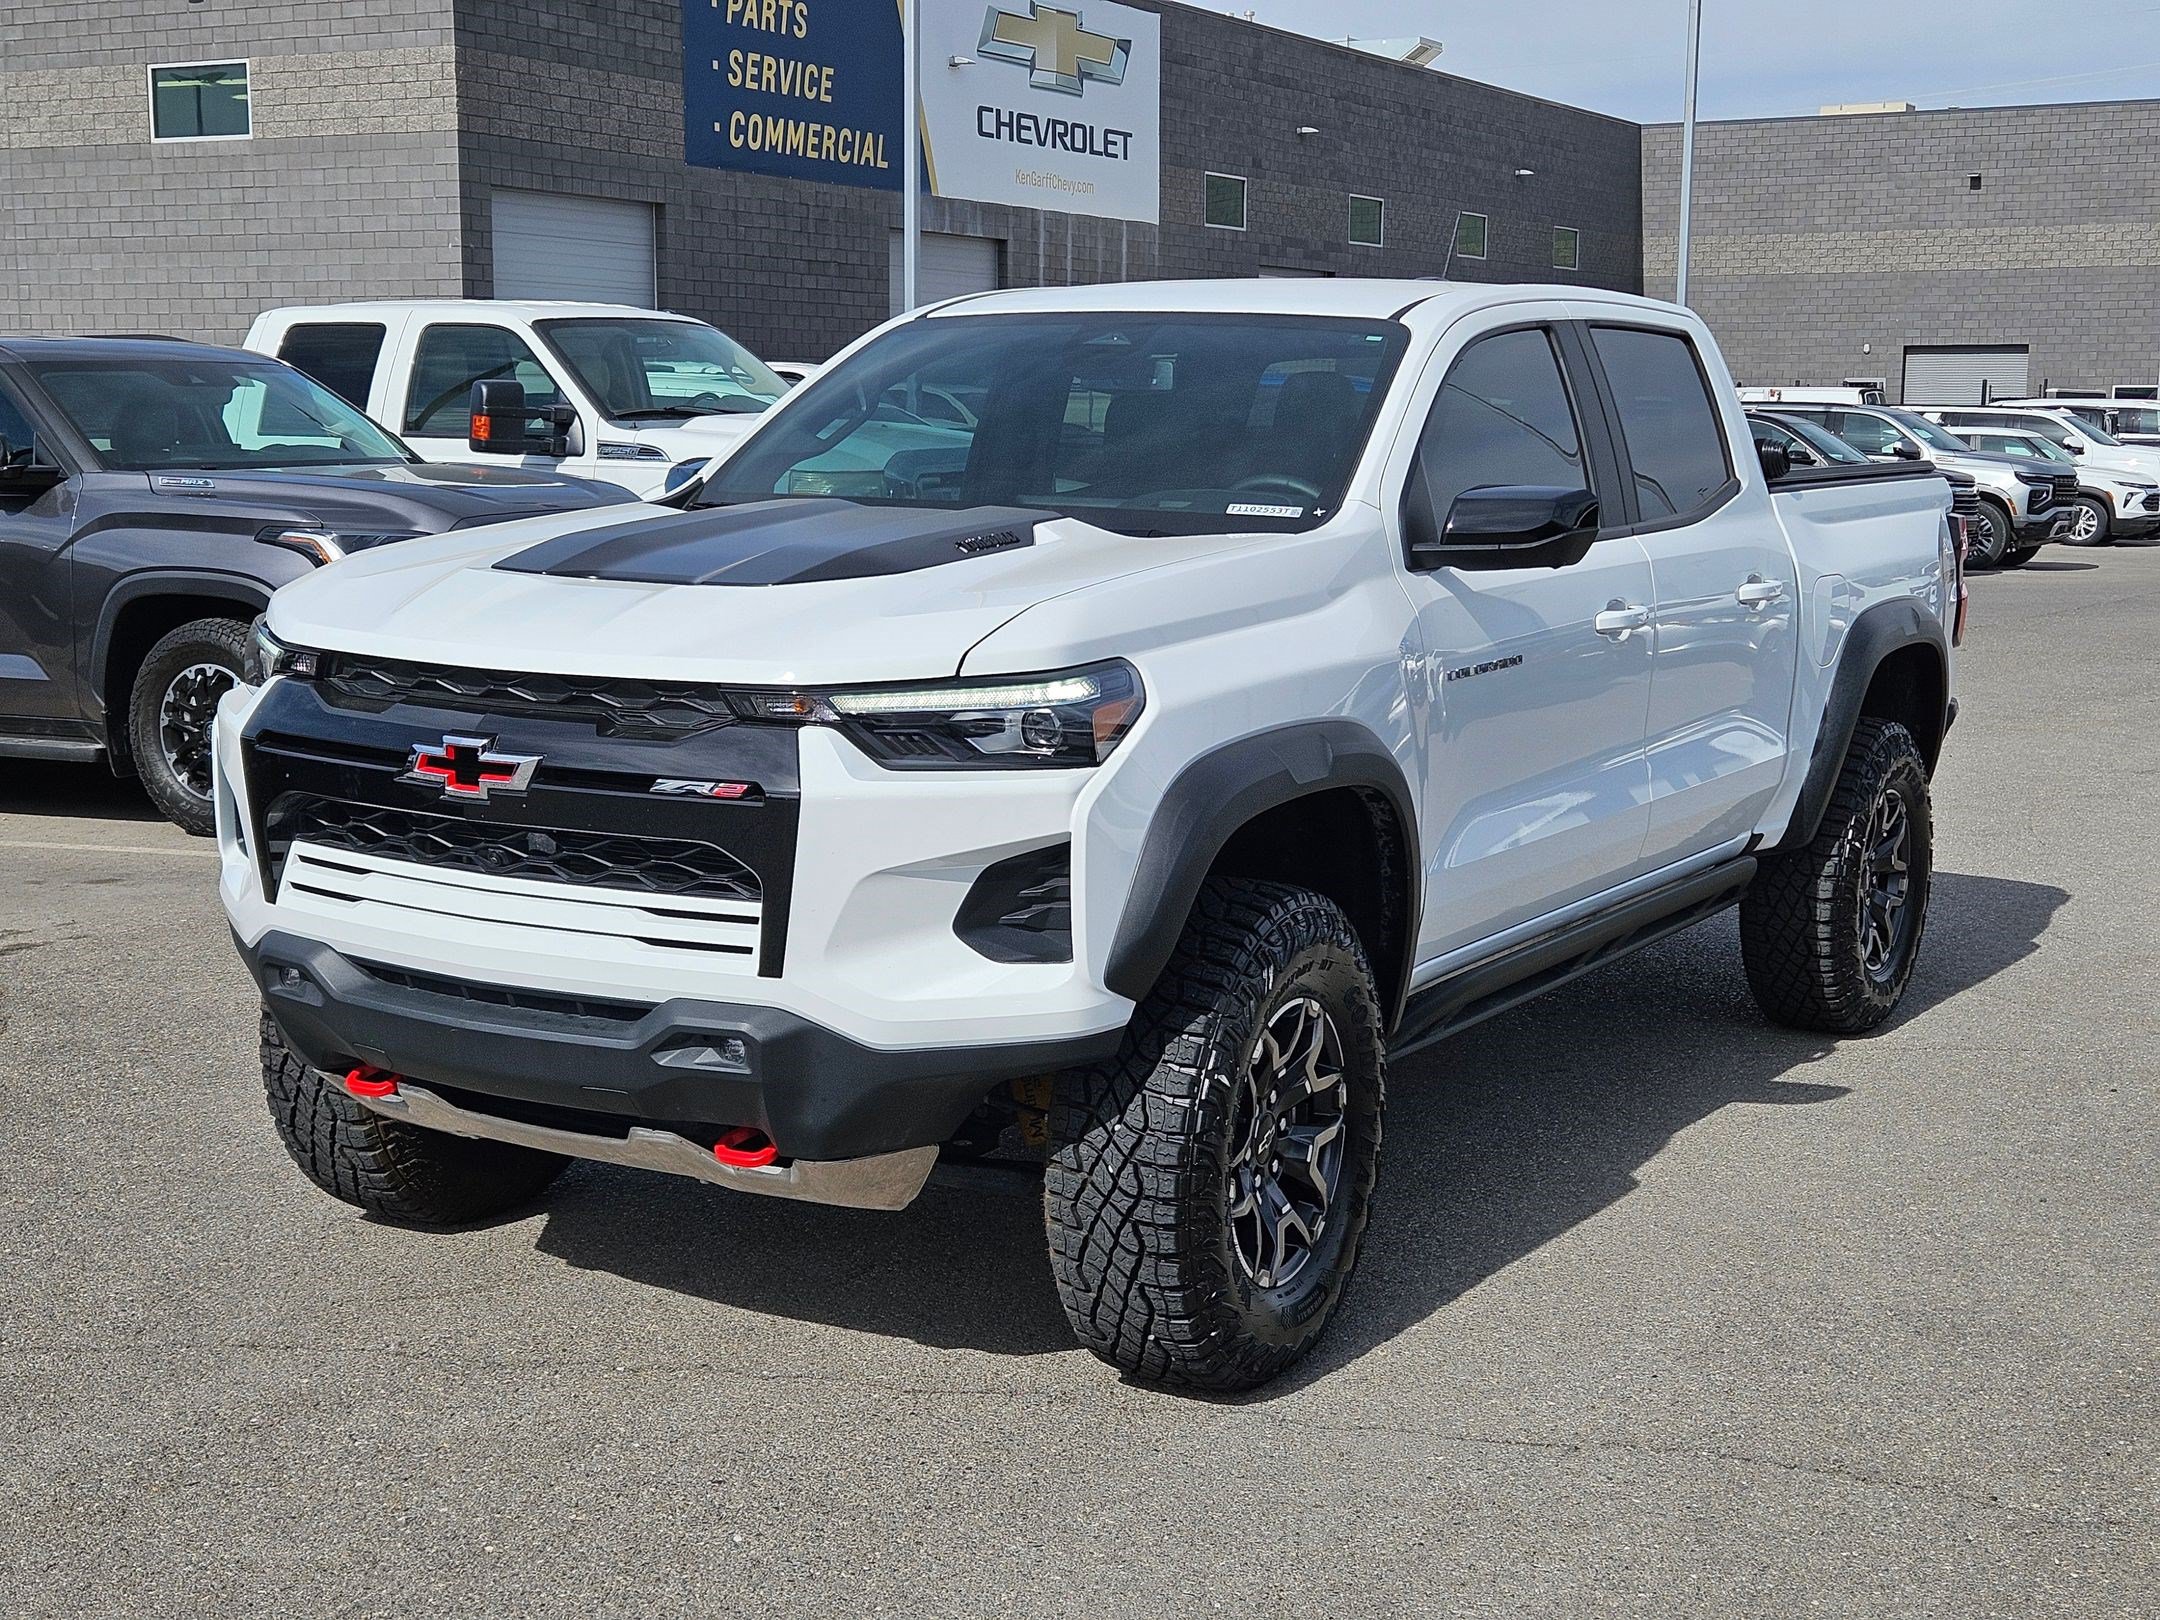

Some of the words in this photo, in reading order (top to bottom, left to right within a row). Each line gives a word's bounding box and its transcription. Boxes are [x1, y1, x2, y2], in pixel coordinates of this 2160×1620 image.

[726, 0, 808, 38] PARTS
[728, 49, 834, 103] SERVICE
[729, 110, 889, 169] COMMERCIAL
[976, 105, 1133, 161] CHEVROLET
[1015, 168, 1095, 196] KenGarffChevy.com
[649, 778, 749, 799] ZR2
